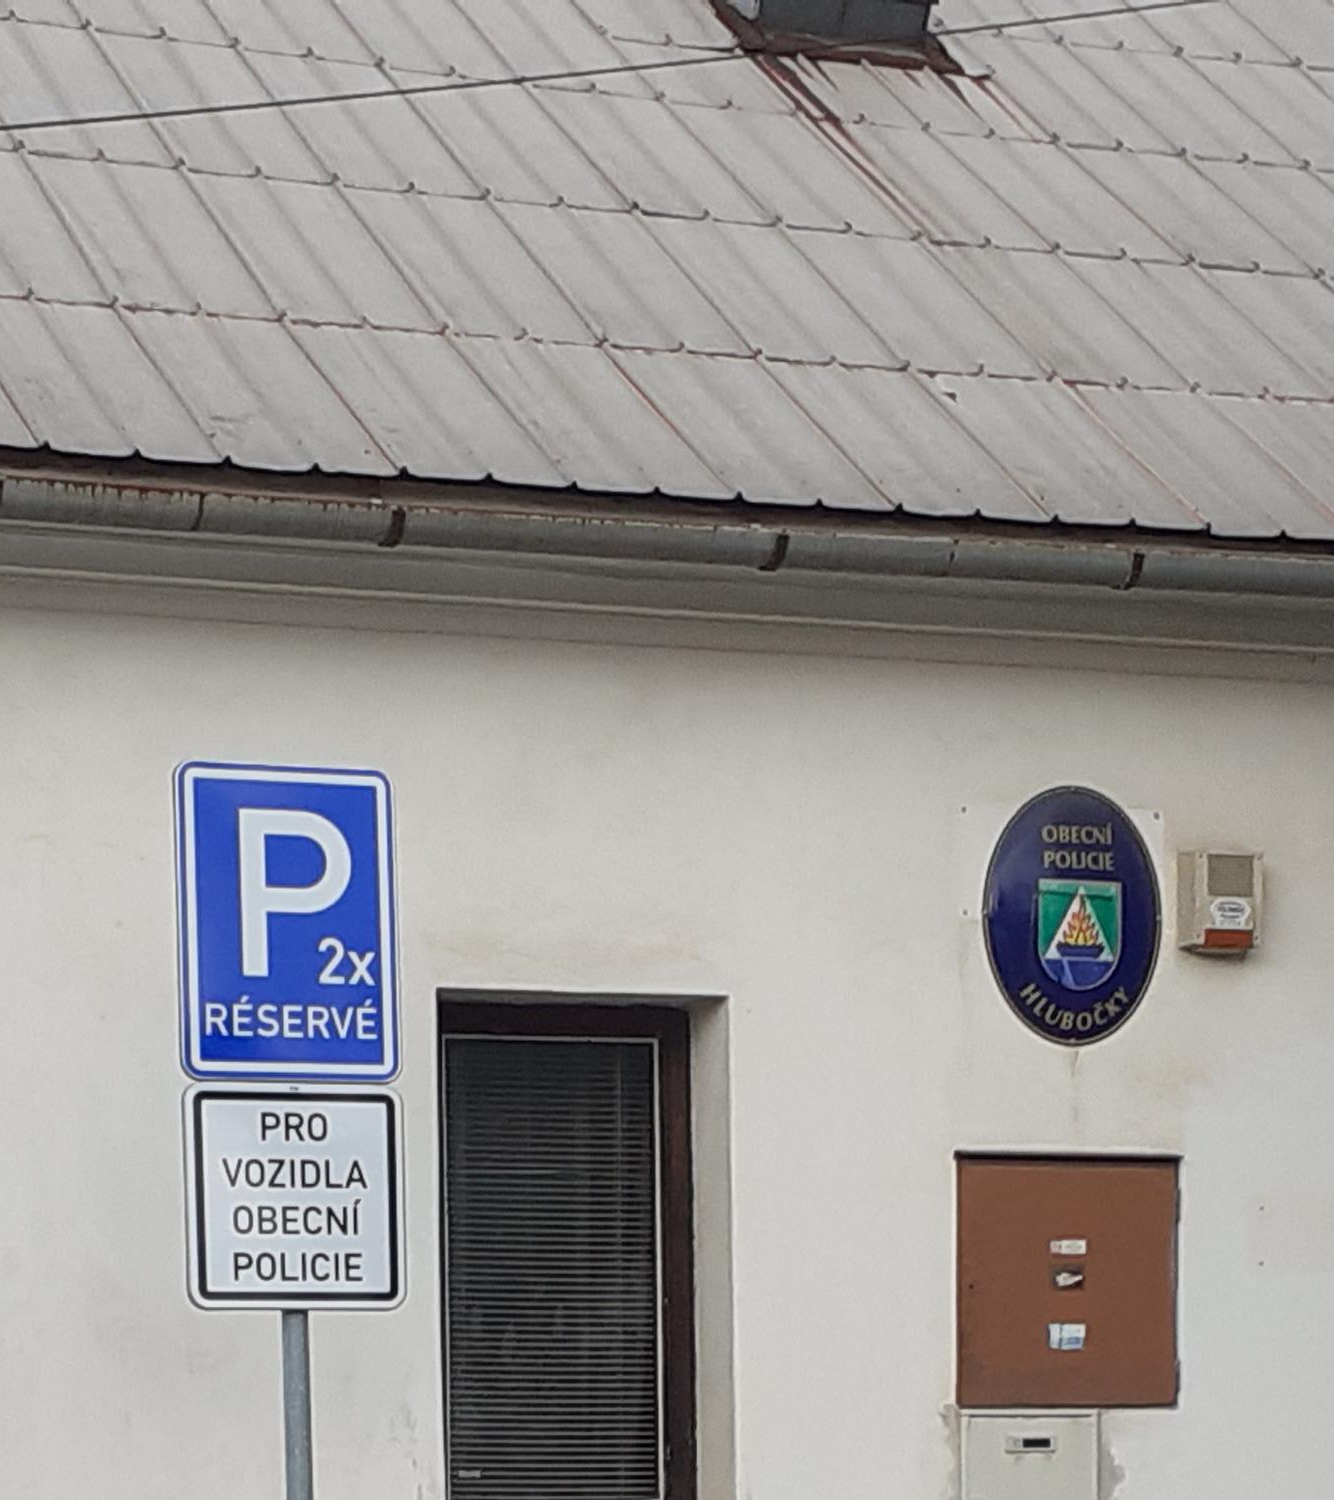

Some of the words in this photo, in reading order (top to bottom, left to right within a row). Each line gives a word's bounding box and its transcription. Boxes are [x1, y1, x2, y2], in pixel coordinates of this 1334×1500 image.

[1041, 822, 1112, 845] OBECNÍ
[1043, 851, 1115, 871] POLICIE
[238, 808, 351, 976] P
[204, 994, 379, 1040] RÉSERVÉ
[1020, 983, 1130, 1031] HLUBOČKY
[259, 1112, 328, 1142] PRO
[221, 1158, 368, 1189] VOZIDLA
[232, 1198, 362, 1235] OBECNÍ
[233, 1252, 364, 1283] POLICIE
